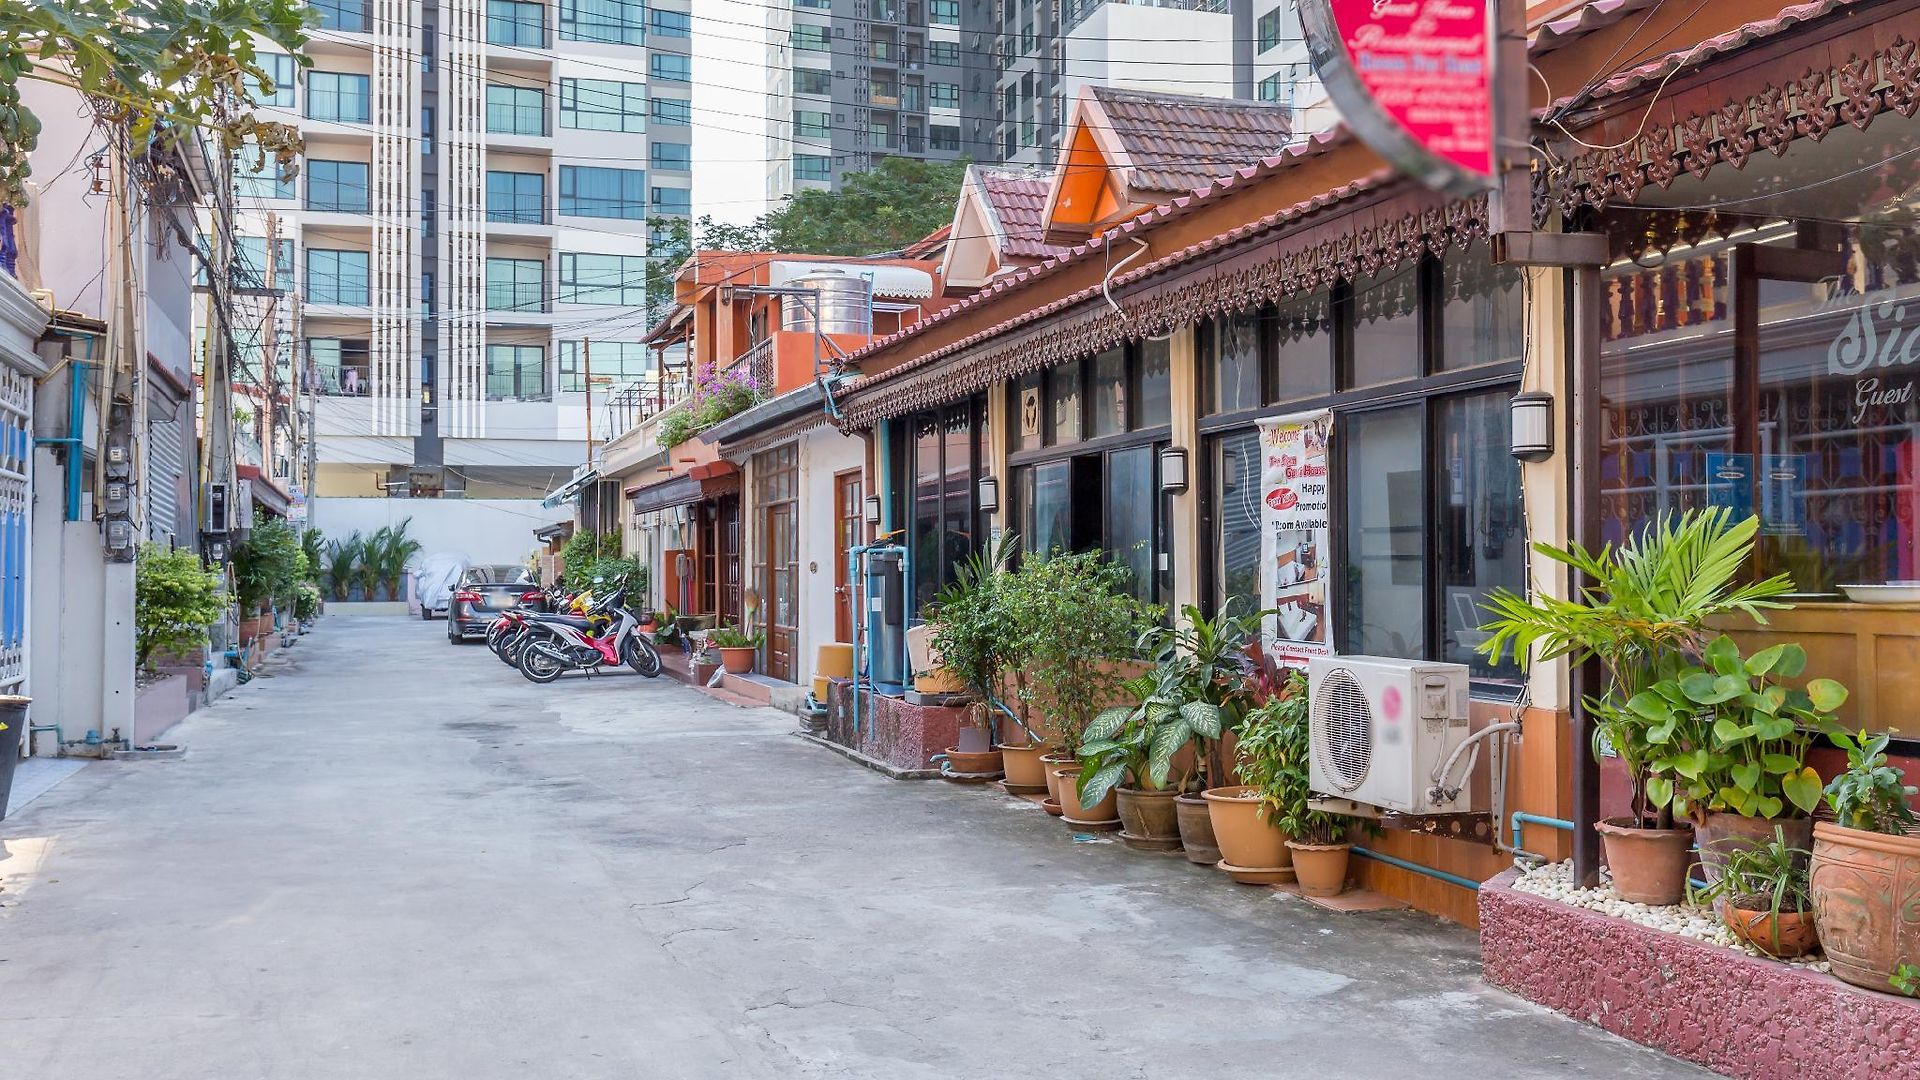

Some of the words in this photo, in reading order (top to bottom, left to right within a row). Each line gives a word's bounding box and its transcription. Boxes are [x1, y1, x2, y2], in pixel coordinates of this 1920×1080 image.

[1370, 0, 1418, 19] Guest
[1852, 378, 1914, 424] Guest
[1269, 427, 1299, 445] Welcome
[1302, 464, 1327, 477] House
[1301, 483, 1326, 495] Happy
